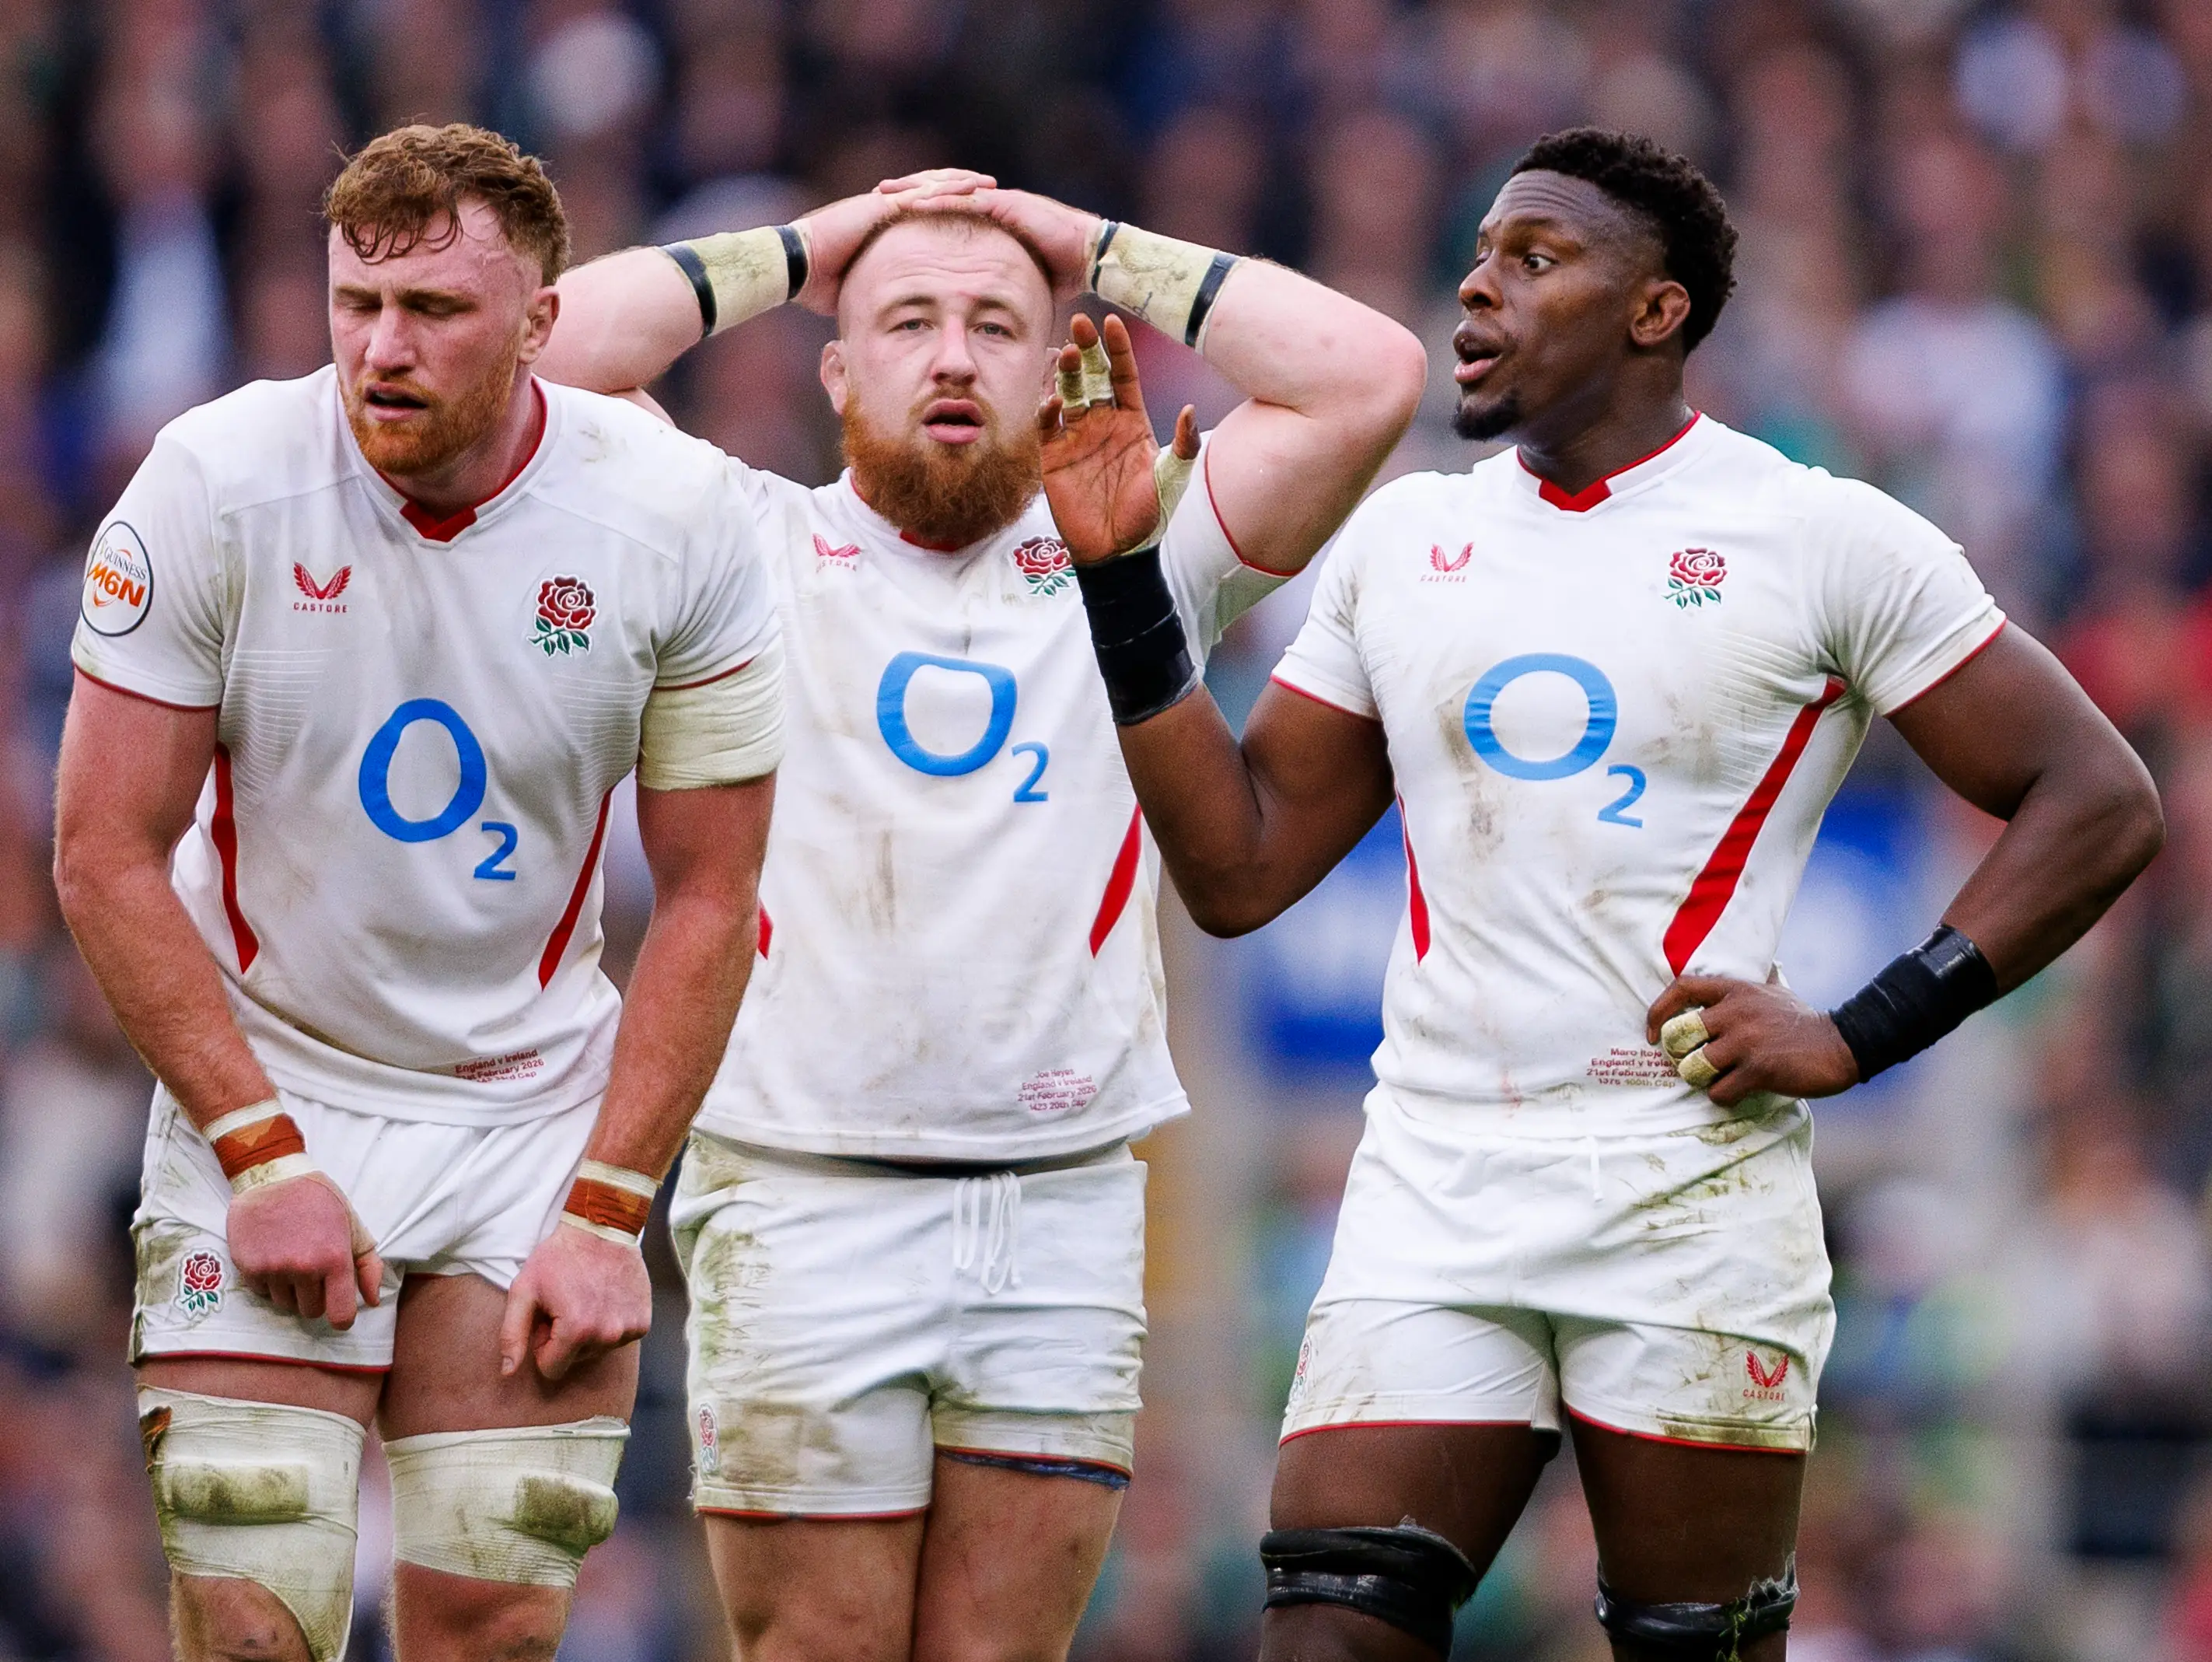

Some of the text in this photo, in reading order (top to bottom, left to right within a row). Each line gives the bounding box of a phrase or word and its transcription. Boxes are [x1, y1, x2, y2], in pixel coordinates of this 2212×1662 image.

[104, 547, 147, 581] GUINNESS
[87, 561, 146, 607] M6N
[293, 602, 348, 613] CASTORE
[1610, 1048, 1637, 1057] Maro
[455, 1058, 497, 1074] England
[505, 1048, 539, 1063] Ireland
[1591, 1058, 1635, 1068] England
[477, 1065, 519, 1079] February
[522, 1058, 544, 1070] 2026
[1586, 1068, 1609, 1076] 21st
[1611, 1069, 1659, 1078] February
[518, 1070, 537, 1079] Cap
[1036, 1070, 1050, 1079] Joe
[1022, 1080, 1057, 1091] England
[1063, 1074, 1092, 1086] Ireland
[1655, 1079, 1676, 1088] Cap
[1037, 1090, 1076, 1100] February
